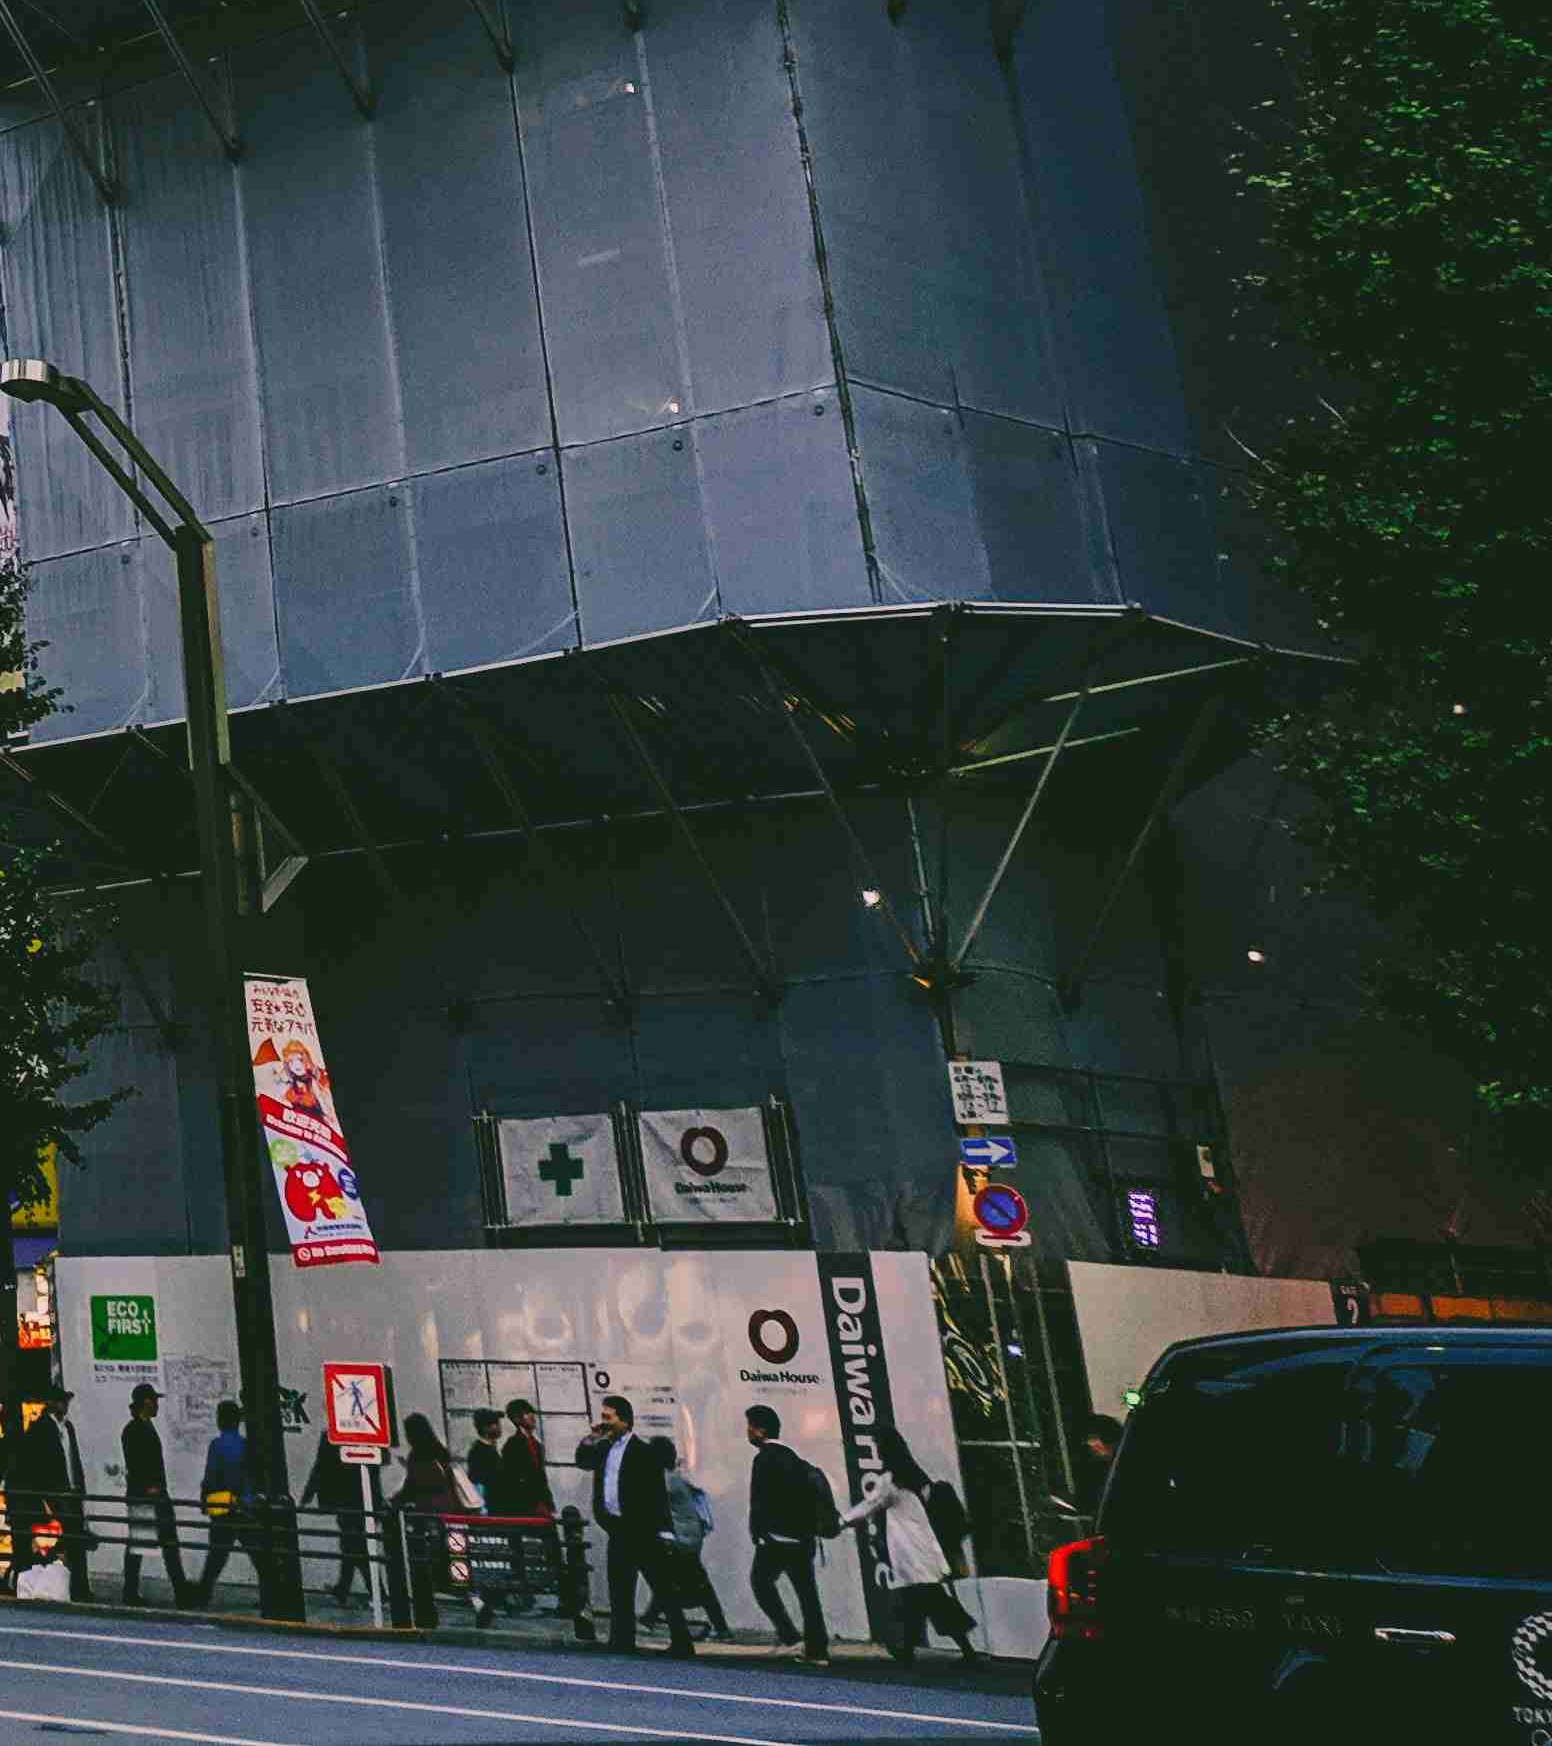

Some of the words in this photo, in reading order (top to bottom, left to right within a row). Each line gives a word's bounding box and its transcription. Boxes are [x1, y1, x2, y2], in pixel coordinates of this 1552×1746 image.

[674, 1182, 711, 1195] Daiwa
[711, 1182, 746, 1194] House
[106, 1300, 139, 1317] ECO
[107, 1314, 151, 1336] FIRST
[832, 1277, 878, 1426] Daiwa
[739, 1369, 779, 1384] Daiwa
[778, 1371, 820, 1385] House
